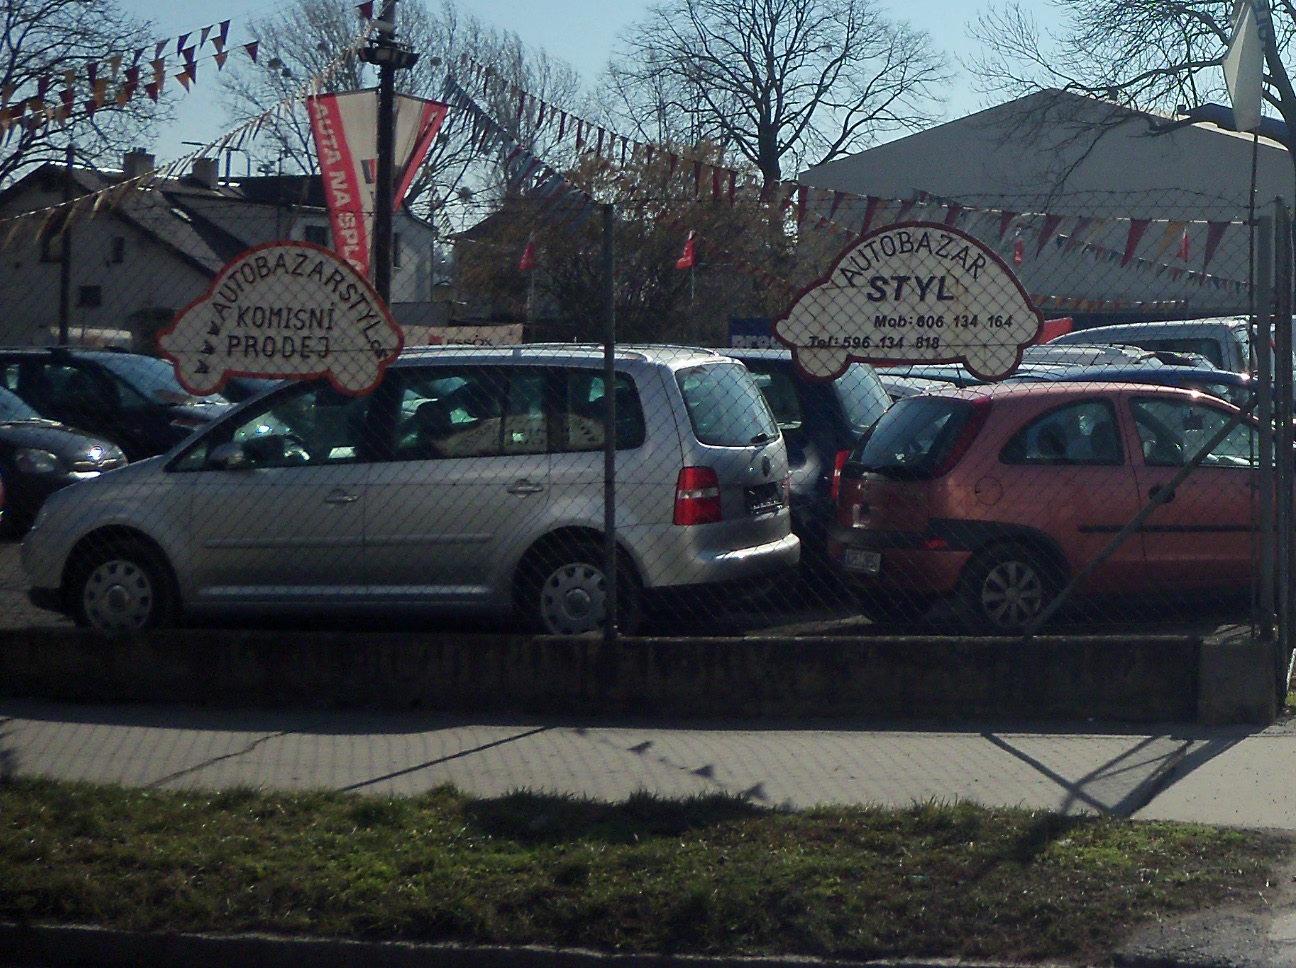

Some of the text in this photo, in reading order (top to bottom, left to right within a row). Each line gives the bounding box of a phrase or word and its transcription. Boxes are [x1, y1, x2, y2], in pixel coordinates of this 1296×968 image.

[328, 171, 351, 207] NA
[840, 231, 987, 286] AUTOBAZAR
[866, 275, 955, 302] STYL
[236, 302, 335, 331] KOMISNÍ
[916, 315, 944, 329] 606
[953, 315, 978, 329] 134
[988, 314, 1013, 328] 164
[226, 335, 330, 359] PRODEJ
[843, 336, 870, 349] 596
[880, 336, 904, 349] 134
[915, 336, 940, 349] 818
